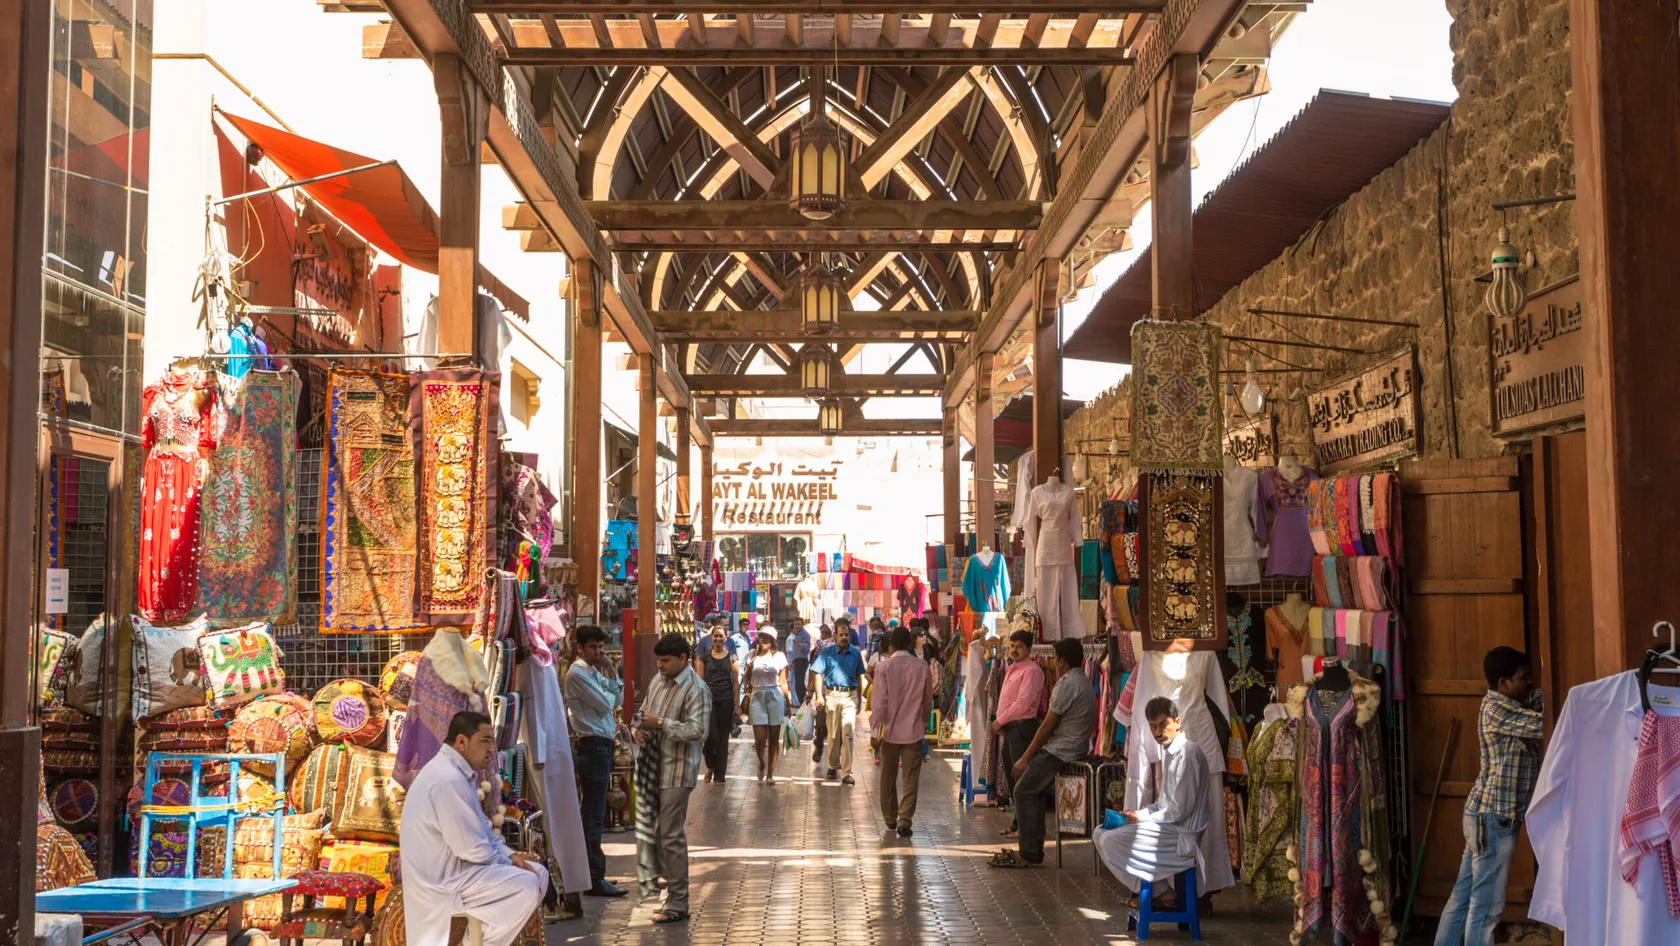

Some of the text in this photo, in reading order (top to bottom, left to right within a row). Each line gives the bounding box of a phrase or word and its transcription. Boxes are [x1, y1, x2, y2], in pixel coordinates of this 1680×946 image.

[1495, 364, 1585, 420] TULSIDAS LALCHAND
[1355, 421, 1388, 455] TRADING
[791, 464, 838, 480] بيت
[712, 482, 838, 500] AYT AL WAKEEL
[723, 508, 822, 525] Restaurant
